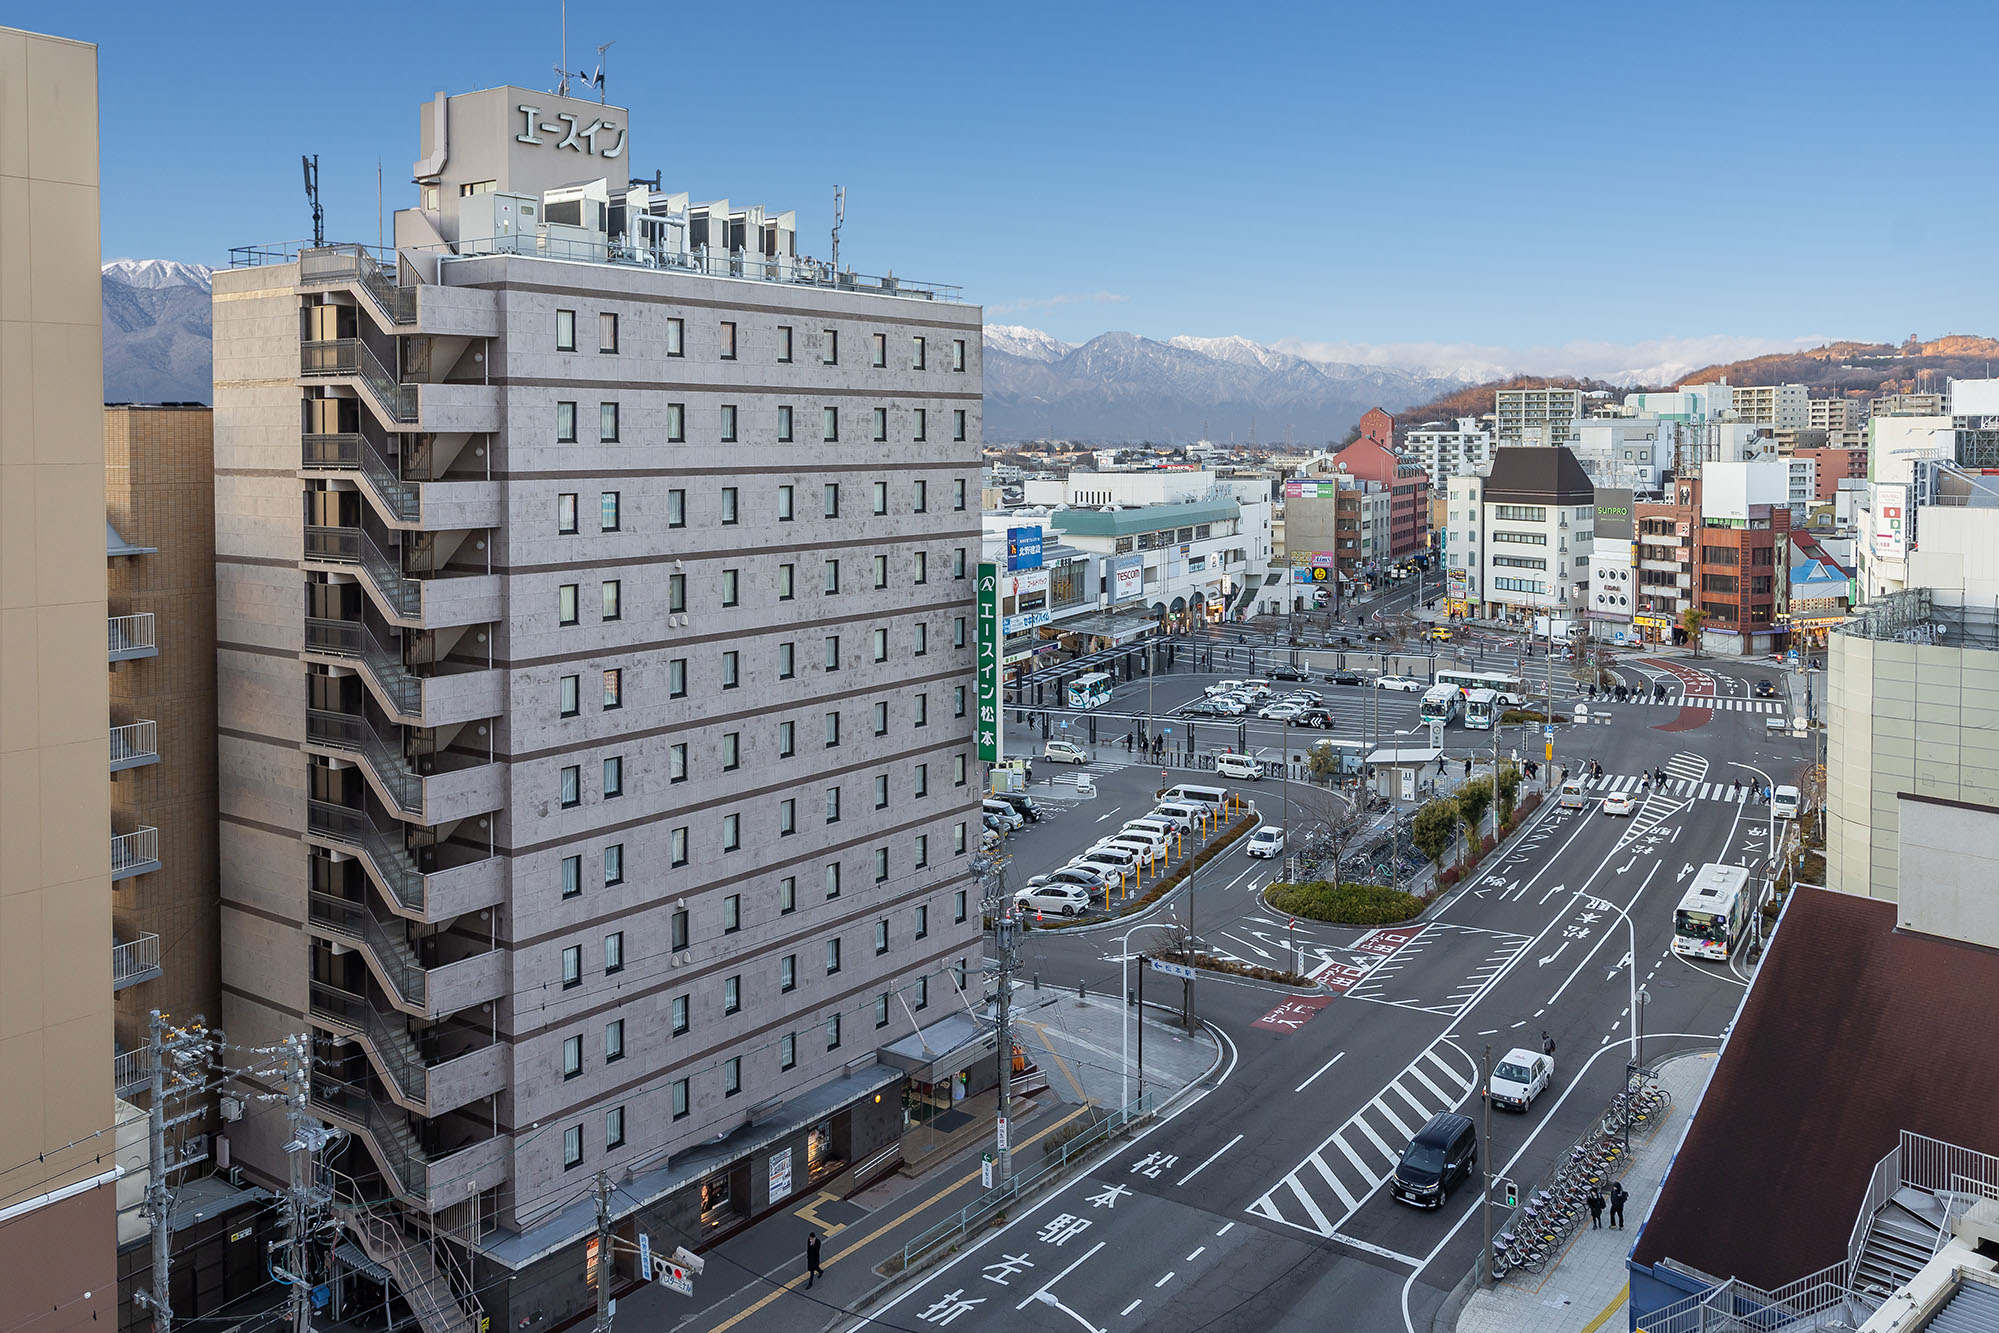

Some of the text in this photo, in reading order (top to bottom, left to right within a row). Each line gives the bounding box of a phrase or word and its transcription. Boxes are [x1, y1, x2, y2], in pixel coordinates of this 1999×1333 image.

[517, 104, 626, 158] エースイン
[1117, 569, 1140, 582] TESCOM
[981, 603, 995, 747] エースイン松本
[1165, 965, 1192, 977] 松本駅
[660, 1273, 691, 1292] バスターミナル
